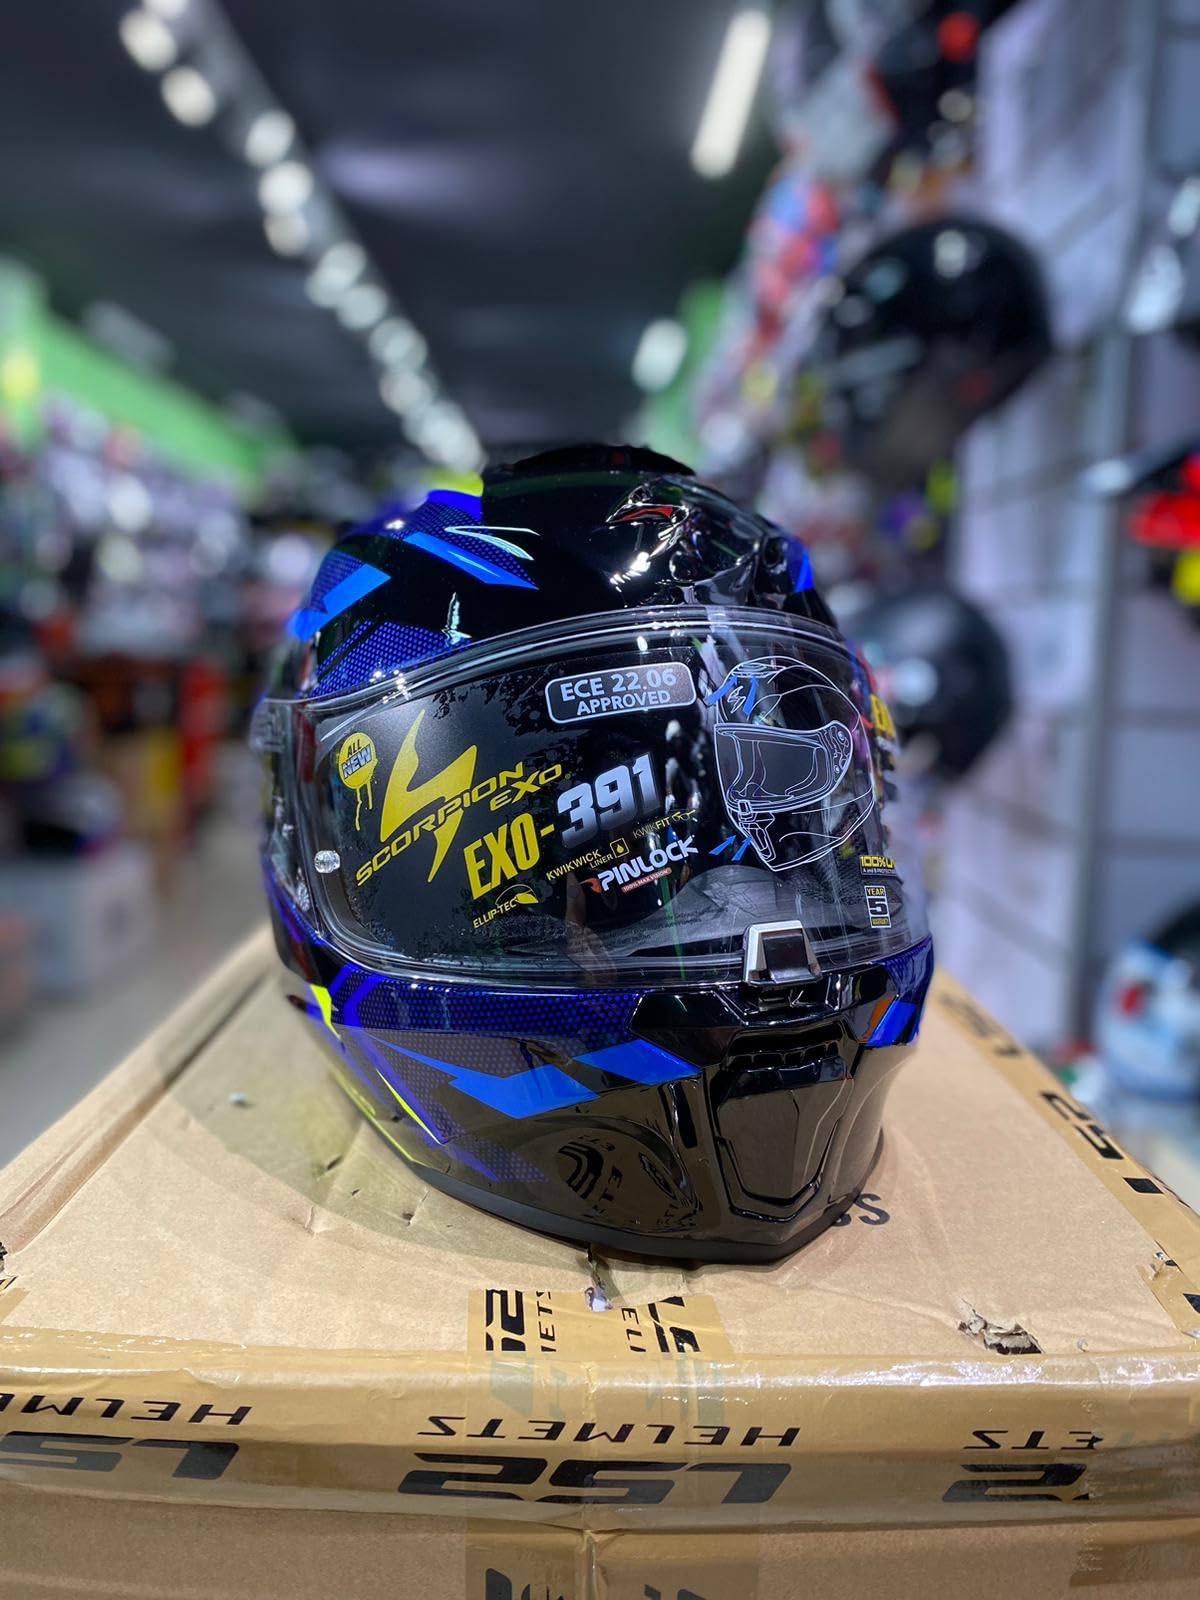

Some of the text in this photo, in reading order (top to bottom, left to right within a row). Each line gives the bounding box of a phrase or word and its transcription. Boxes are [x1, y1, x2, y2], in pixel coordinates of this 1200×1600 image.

[560, 667, 678, 702] ECE 22.06
[576, 688, 672, 717] APPROVED
[343, 745, 372, 779] NEW
[347, 739, 361, 758] ALL
[356, 761, 525, 887] SCORPION
[546, 848, 602, 881] KWIKWICK
[589, 852, 613, 869] LINER
[598, 836, 699, 891] PINLOCK
[867, 888, 885, 896] YEAR
[473, 899, 518, 930] ELLIP-TEC
[0, 1393, 252, 1426] HELM
[417, 1415, 801, 1447] HELMETS
[398, 1452, 793, 1505] LS2
